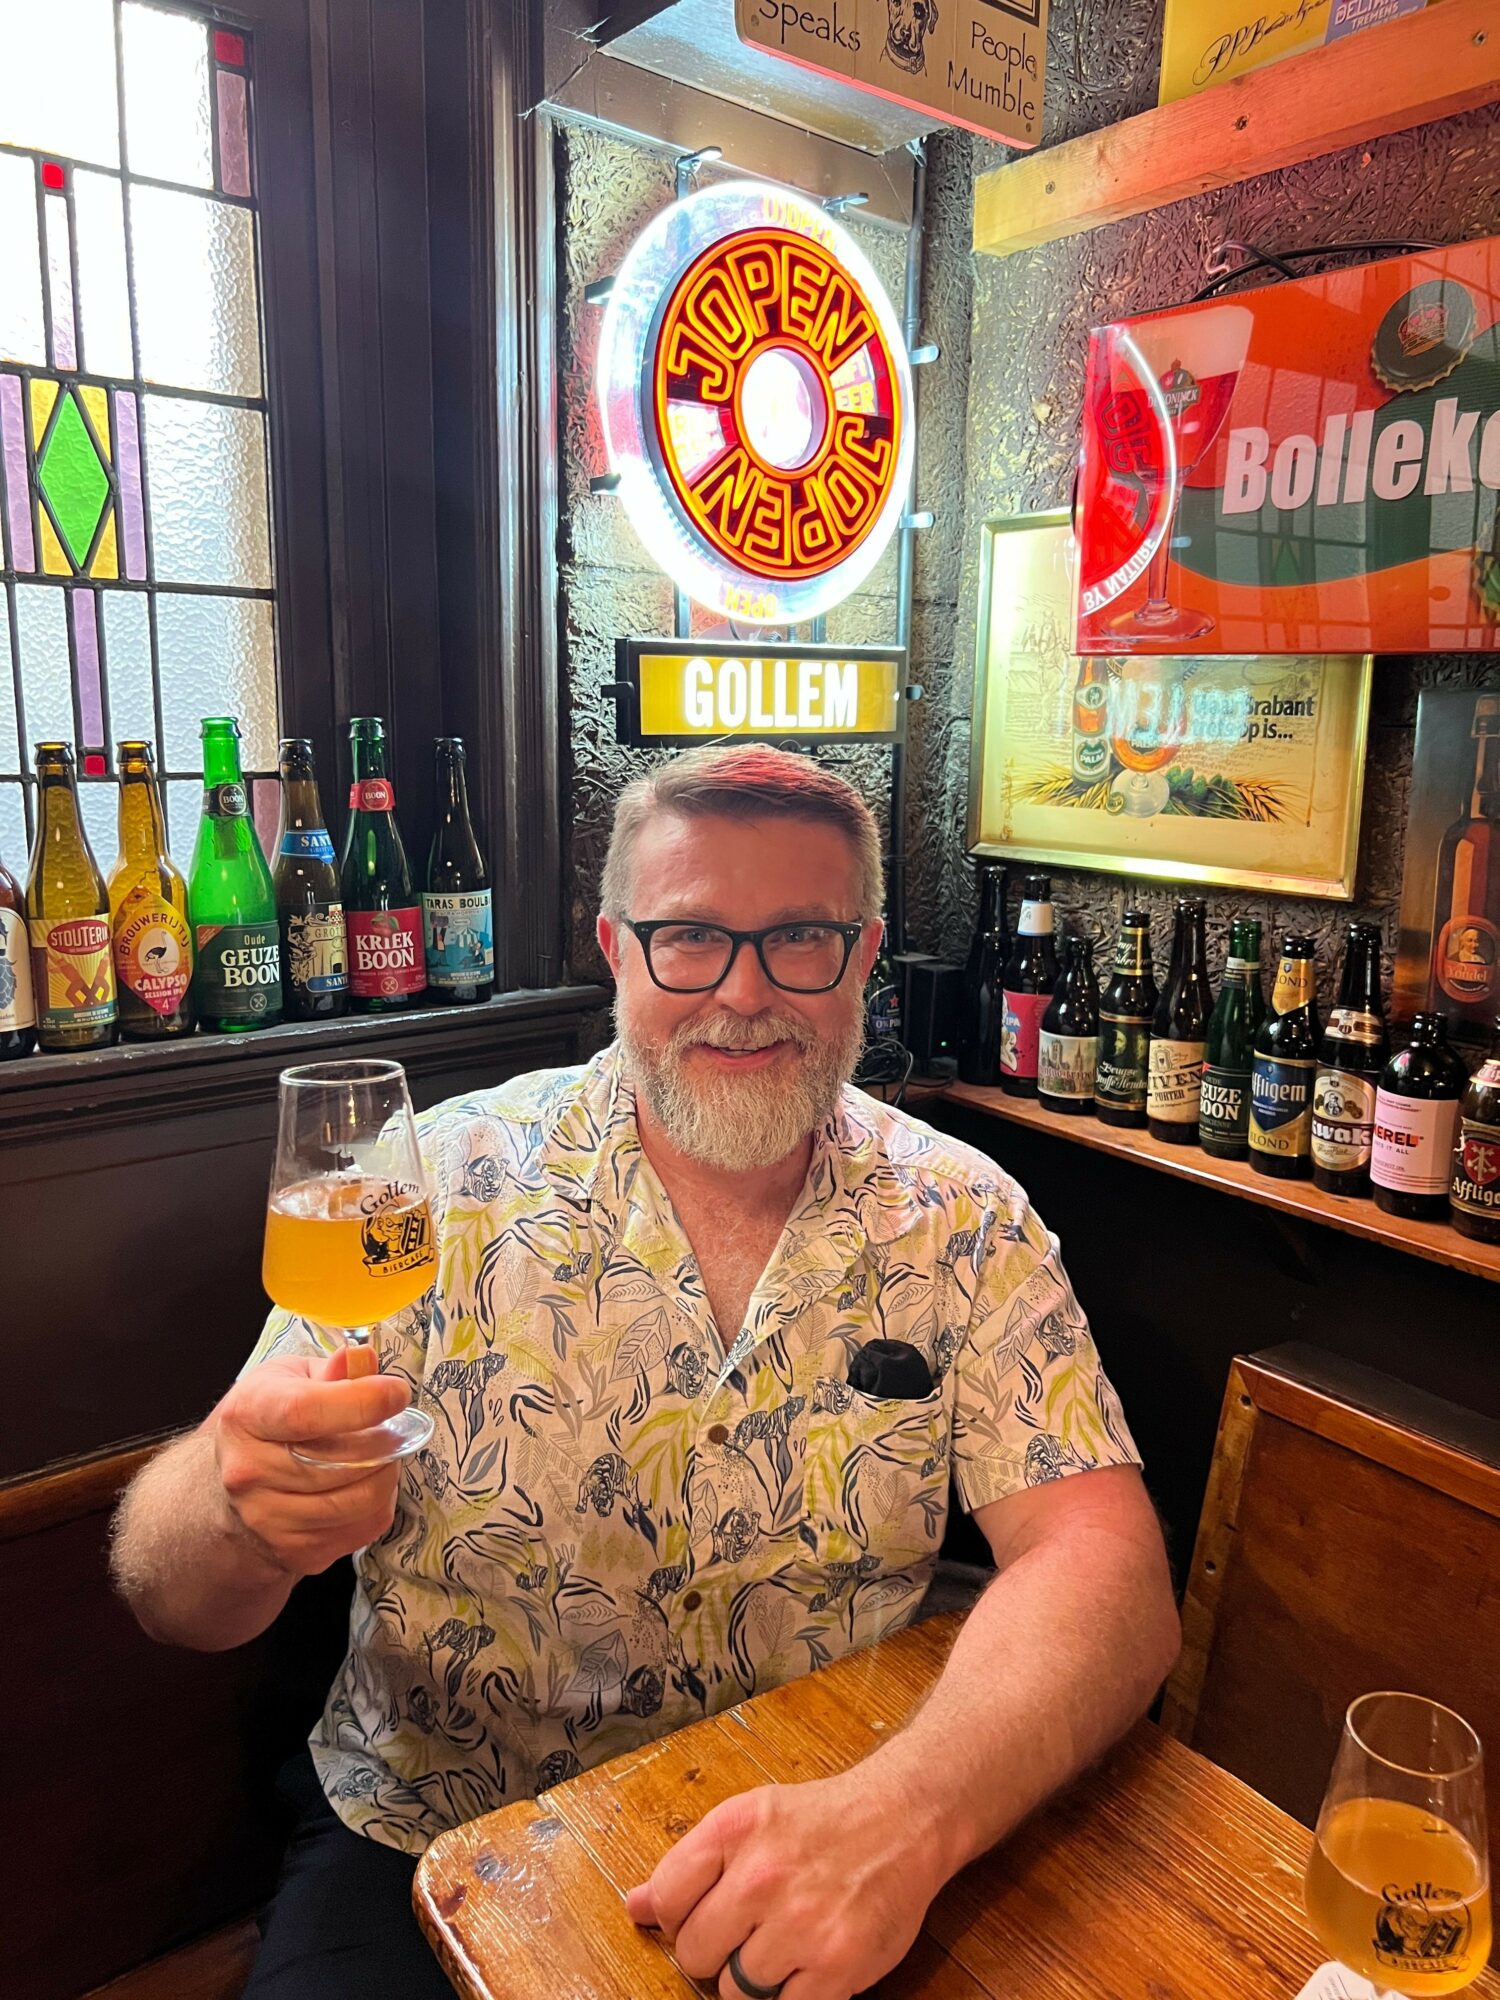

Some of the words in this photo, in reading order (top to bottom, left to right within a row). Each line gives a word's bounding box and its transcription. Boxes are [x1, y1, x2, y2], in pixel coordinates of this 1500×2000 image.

[971, 21, 1036, 83] People
[947, 60, 1036, 121] Mumble
[667, 243, 876, 402] JOPEN
[691, 416, 892, 566] JOPEN
[684, 659, 859, 729] GOLLEM
[1080, 751, 1105, 765] PALM
[365, 791, 386, 800] BOON
[426, 898, 454, 910] TARAS
[244, 933, 266, 946] Oude
[220, 944, 280, 967] GEUZE
[357, 947, 415, 971] BOON
[134, 973, 188, 992] CALYPSO
[223, 961, 280, 988] BOON
[144, 989, 172, 999] SESSION
[173, 987, 183, 996] IPA
[1154, 1089, 1185, 1102] PORTER
[1201, 1080, 1242, 1105] EUZE
[361, 1181, 420, 1215] Gollem
